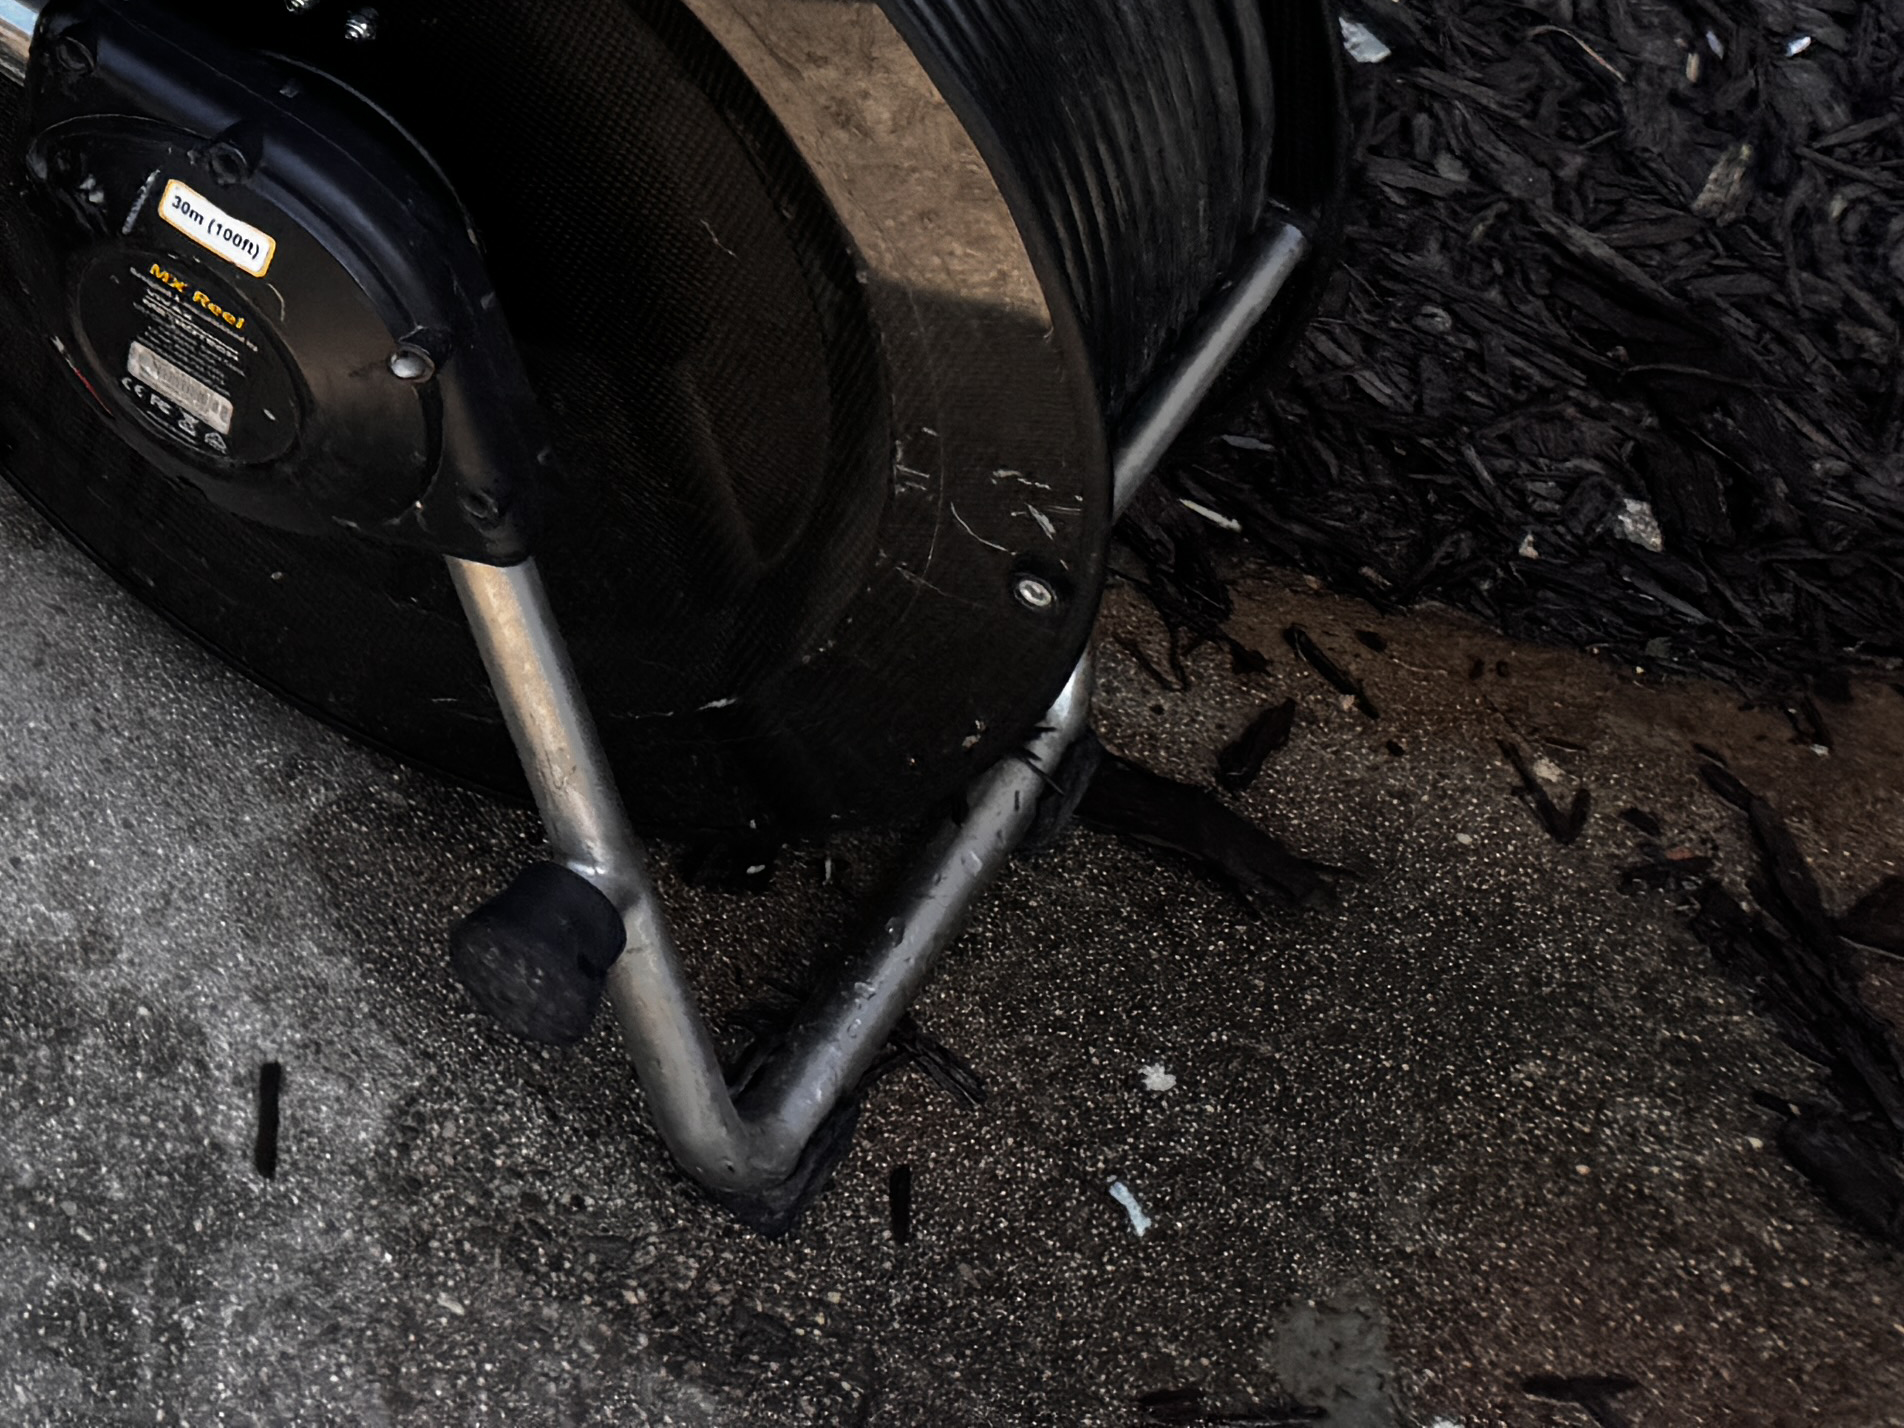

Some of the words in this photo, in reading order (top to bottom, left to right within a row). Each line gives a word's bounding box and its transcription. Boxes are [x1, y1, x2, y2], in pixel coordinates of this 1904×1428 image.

[172, 194, 204, 225] 30m
[207, 218, 261, 260] (100ft)
[150, 264, 188, 293] MX
[193, 291, 245, 329] Reel
